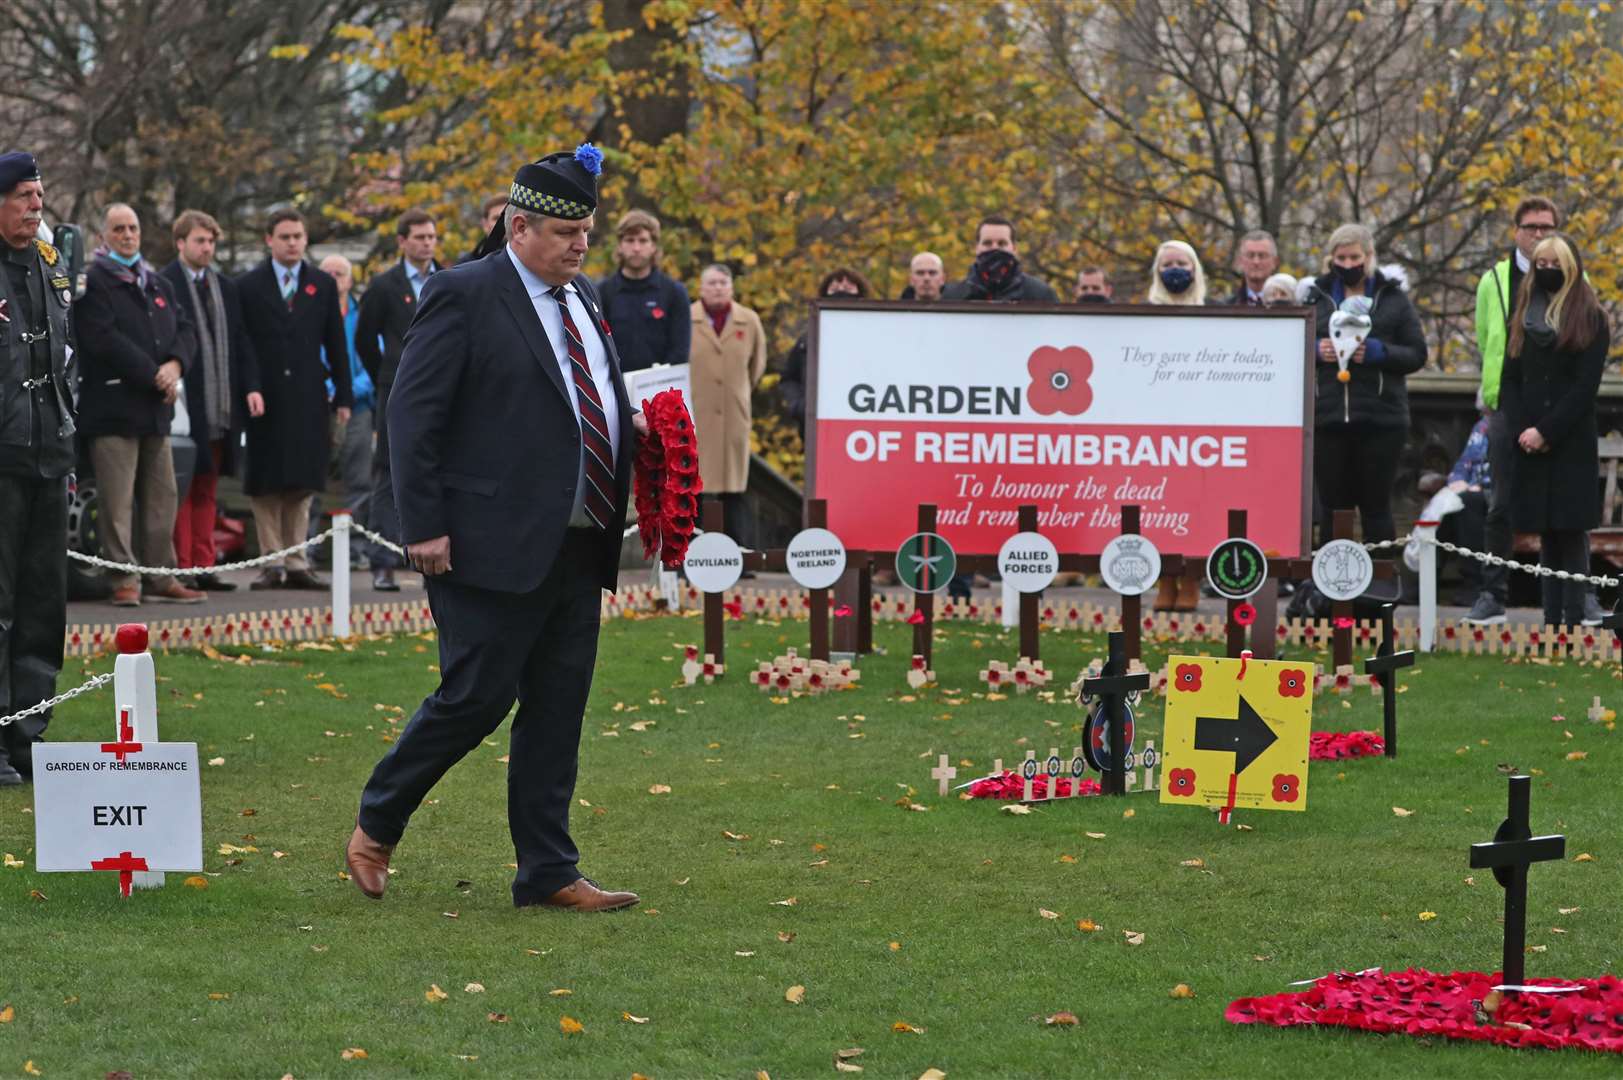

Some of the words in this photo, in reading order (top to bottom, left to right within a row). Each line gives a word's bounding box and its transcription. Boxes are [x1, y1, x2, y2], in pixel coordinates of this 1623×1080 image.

[1121, 346, 1156, 366] They
[1157, 351, 1191, 367] gave
[1195, 346, 1230, 363] their
[1233, 347, 1274, 368] today,
[1148, 367, 1174, 386] for
[1178, 370, 1203, 382] our
[1206, 369, 1275, 382] tomorrow
[848, 383, 1021, 416] GARDEN
[846, 430, 902, 462] OF
[915, 431, 1248, 468] REMEMBRANCE
[955, 474, 984, 497] To
[990, 474, 1069, 499] honour
[1074, 475, 1108, 500] the
[1114, 477, 1167, 501] dead
[977, 503, 1085, 527] remmber
[1089, 504, 1122, 528] the
[1139, 505, 1190, 536] iving
[687, 558, 740, 568] CIVILIANS
[791, 549, 841, 559] NORTHERN
[1008, 551, 1049, 561] ALLIED
[797, 559, 836, 569] IRELAND
[1004, 564, 1053, 574] FORCES
[46, 762, 90, 771] GARDEN
[93, 762, 107, 771] OF
[109, 761, 188, 771] REMEMBRANCE
[93, 805, 148, 827] EXIT
